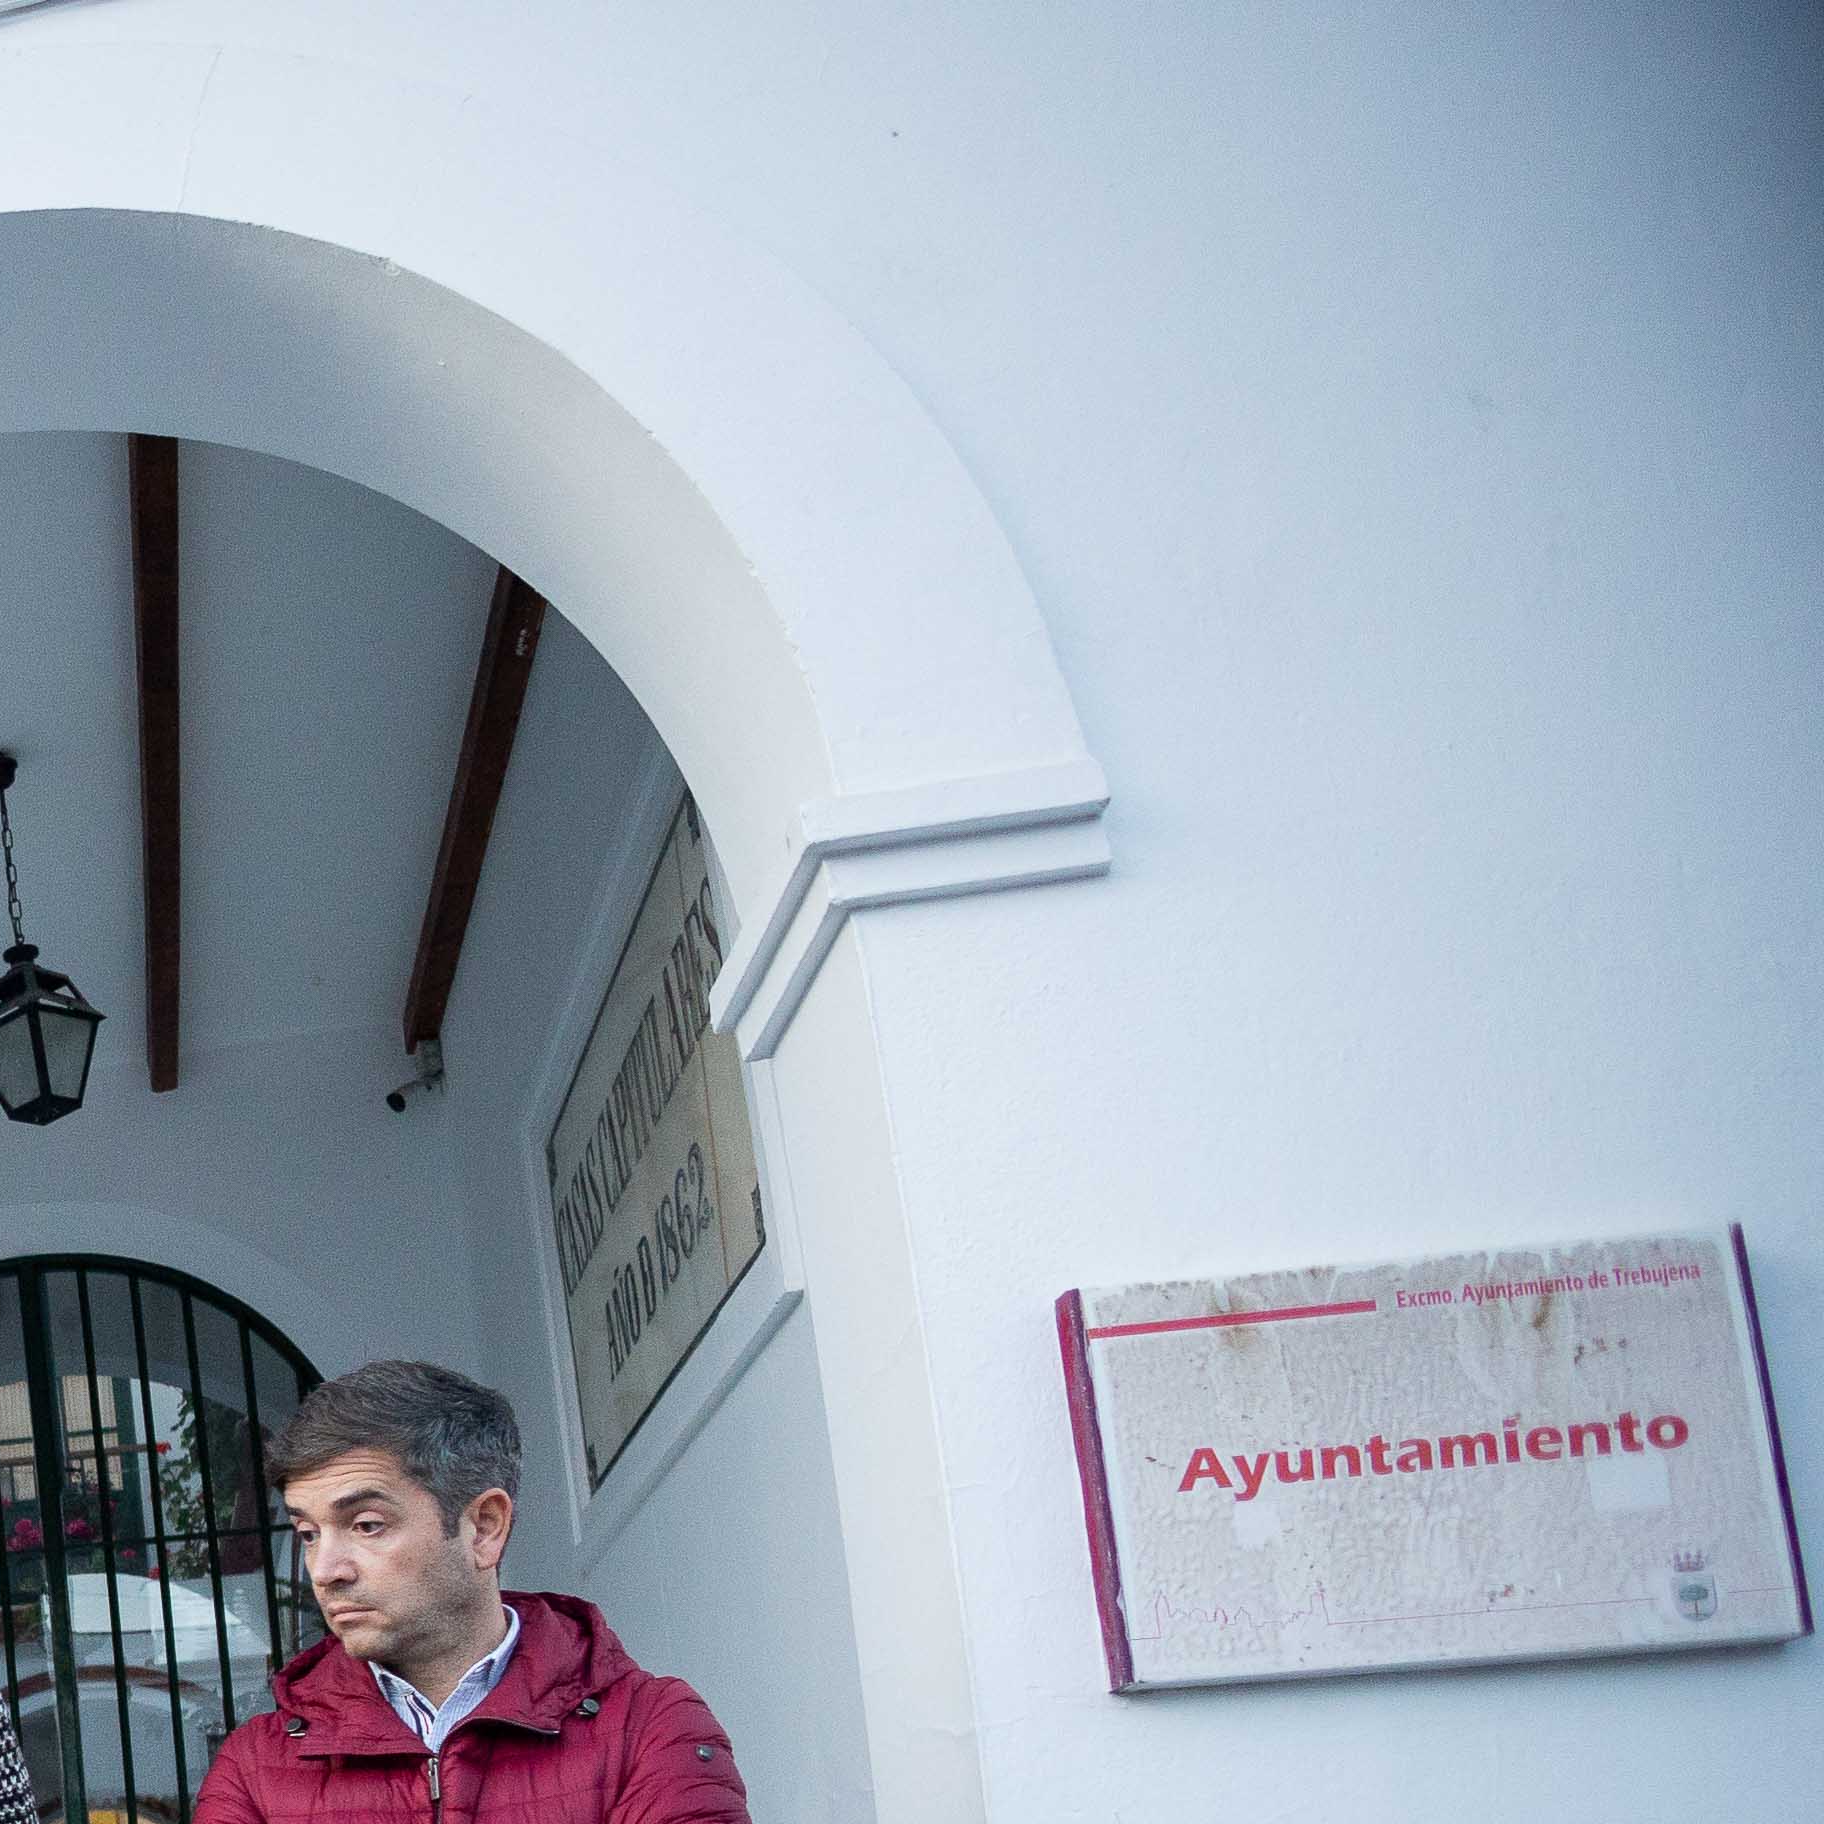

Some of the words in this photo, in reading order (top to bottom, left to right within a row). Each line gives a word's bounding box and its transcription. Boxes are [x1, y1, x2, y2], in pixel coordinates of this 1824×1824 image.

[606, 1262, 641, 1383] AÑO
[1396, 1288, 1457, 1308] Excmo.
[1462, 1274, 1584, 1306] Ayuntamiento
[1588, 1271, 1609, 1289] de
[1612, 1263, 1701, 1288] Trebujena
[1178, 1410, 1689, 1502] Ayuntamiento
